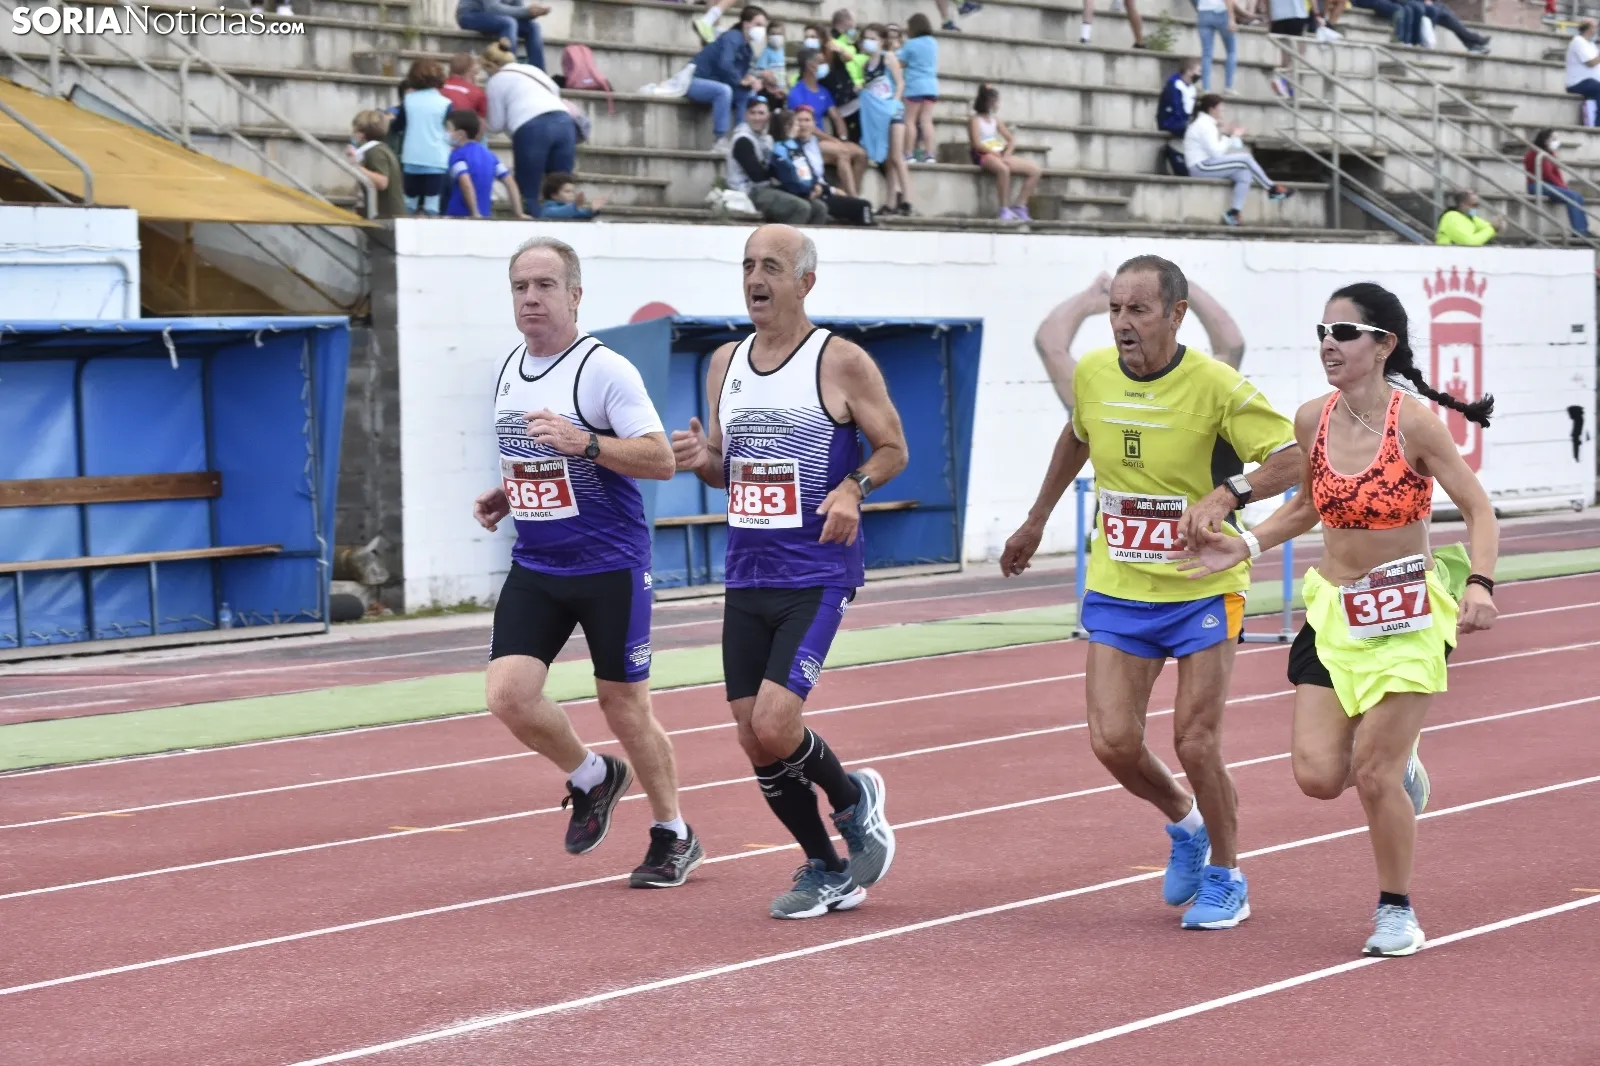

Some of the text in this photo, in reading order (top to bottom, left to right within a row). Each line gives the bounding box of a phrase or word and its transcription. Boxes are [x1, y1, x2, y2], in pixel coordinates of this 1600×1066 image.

[738, 437, 777, 447] SORIA
[524, 464, 538, 473] ABEL
[540, 460, 563, 472] ANTÓN
[752, 466, 767, 474] ABEL
[768, 463, 793, 474] ANTÓN
[1121, 458, 1145, 469] Soria
[506, 480, 561, 508] 362
[733, 483, 786, 514] 383
[1137, 501, 1155, 510] ABEL
[1156, 500, 1182, 511] ANTÓN
[739, 517, 770, 525] ALFONSO
[1107, 516, 1174, 549] 374
[1115, 549, 1163, 559] JAVIER LUIS
[1385, 566, 1406, 578] ABEL
[1353, 582, 1427, 624] 327
[1381, 621, 1411, 632] LAURA
